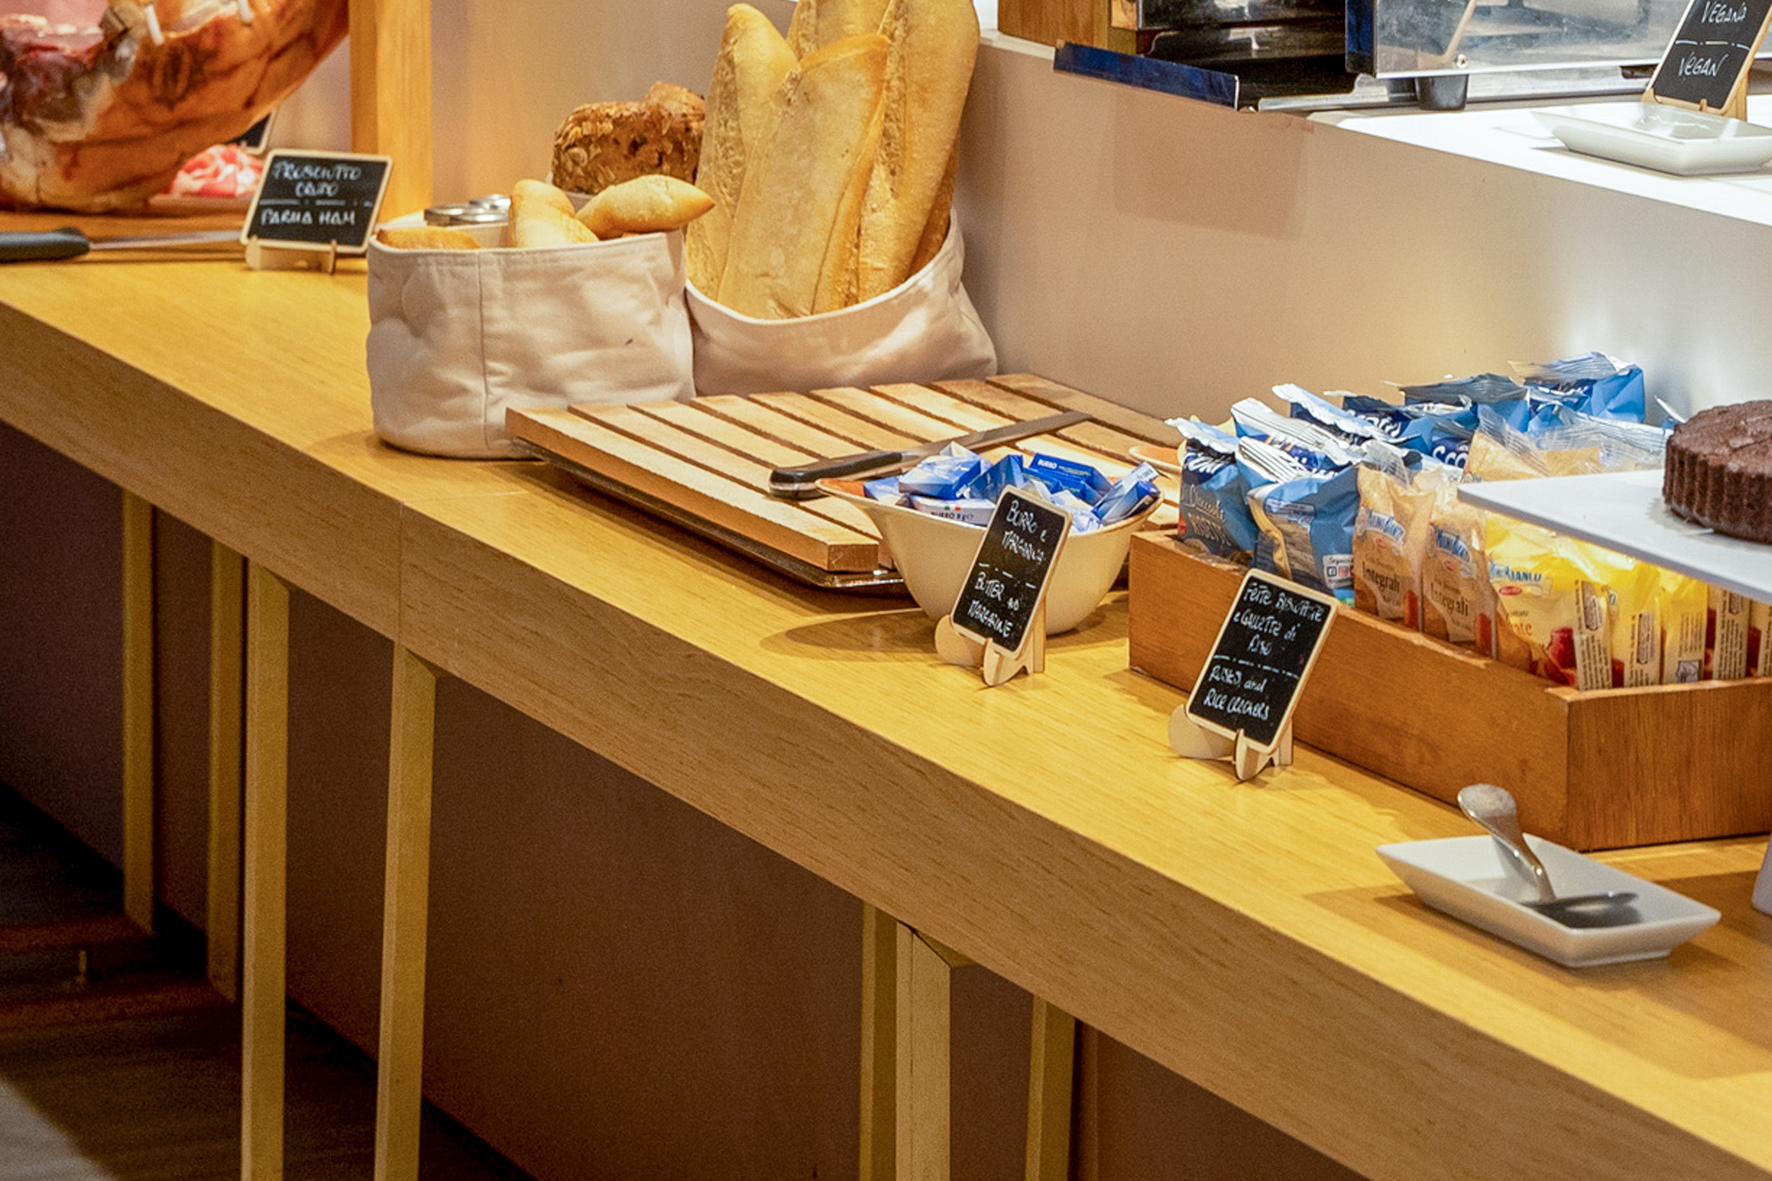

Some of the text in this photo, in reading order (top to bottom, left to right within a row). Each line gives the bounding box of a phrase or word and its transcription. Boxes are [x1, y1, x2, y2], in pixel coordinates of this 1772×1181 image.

[1701, 1, 1748, 24] VEGANA
[1678, 51, 1730, 77] VEGAN
[261, 208, 356, 226] PARMA HAM
[1432, 445, 1470, 467] Sco
[974, 570, 1006, 602] BUTTER
